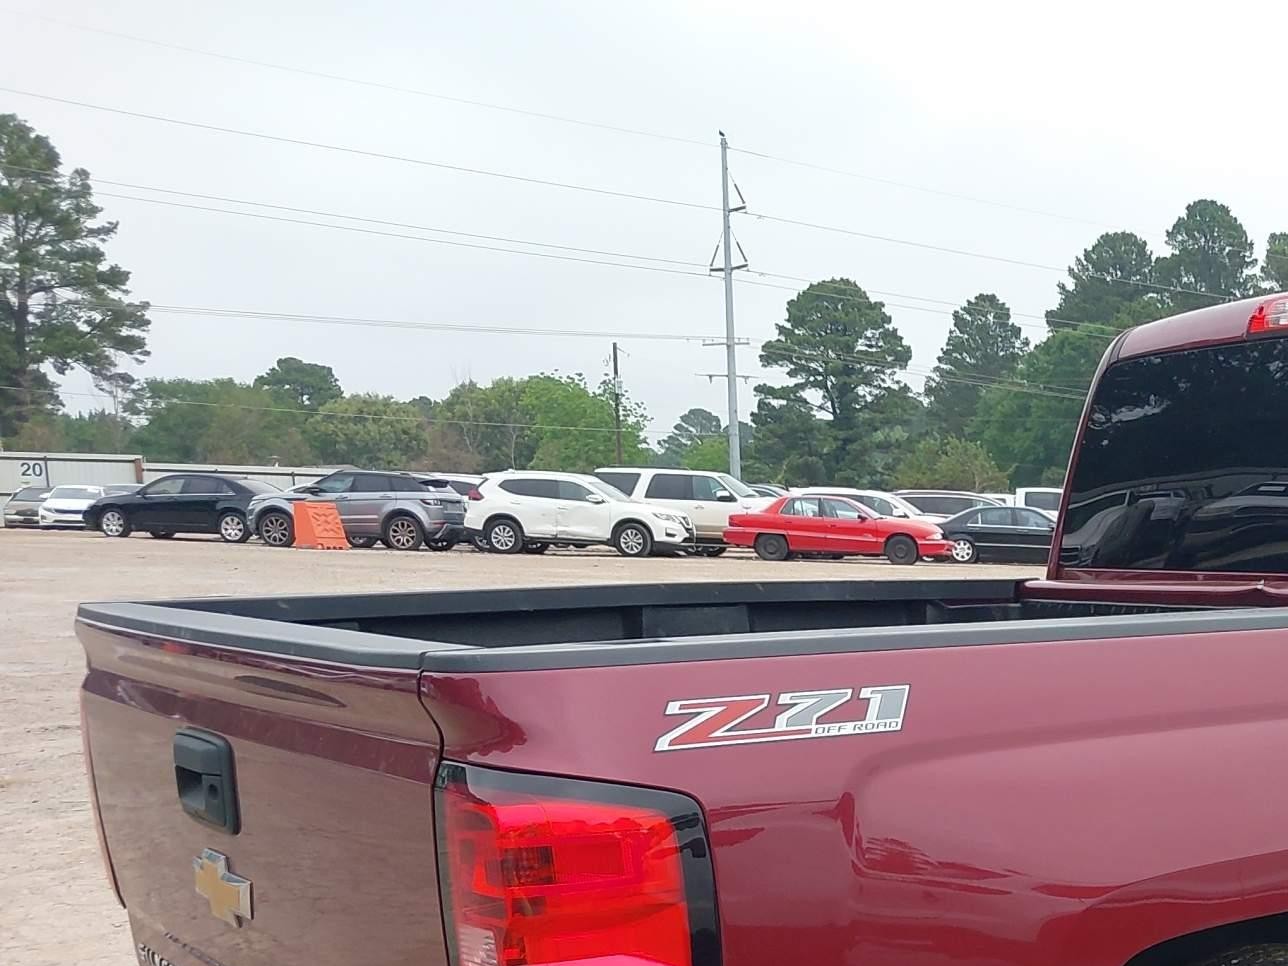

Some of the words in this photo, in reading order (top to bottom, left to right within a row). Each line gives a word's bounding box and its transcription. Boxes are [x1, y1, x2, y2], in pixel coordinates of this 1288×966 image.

[20, 462, 42, 477] 20
[653, 684, 911, 753] Z71
[814, 726, 848, 735] OFF
[852, 720, 899, 732] ROAD
